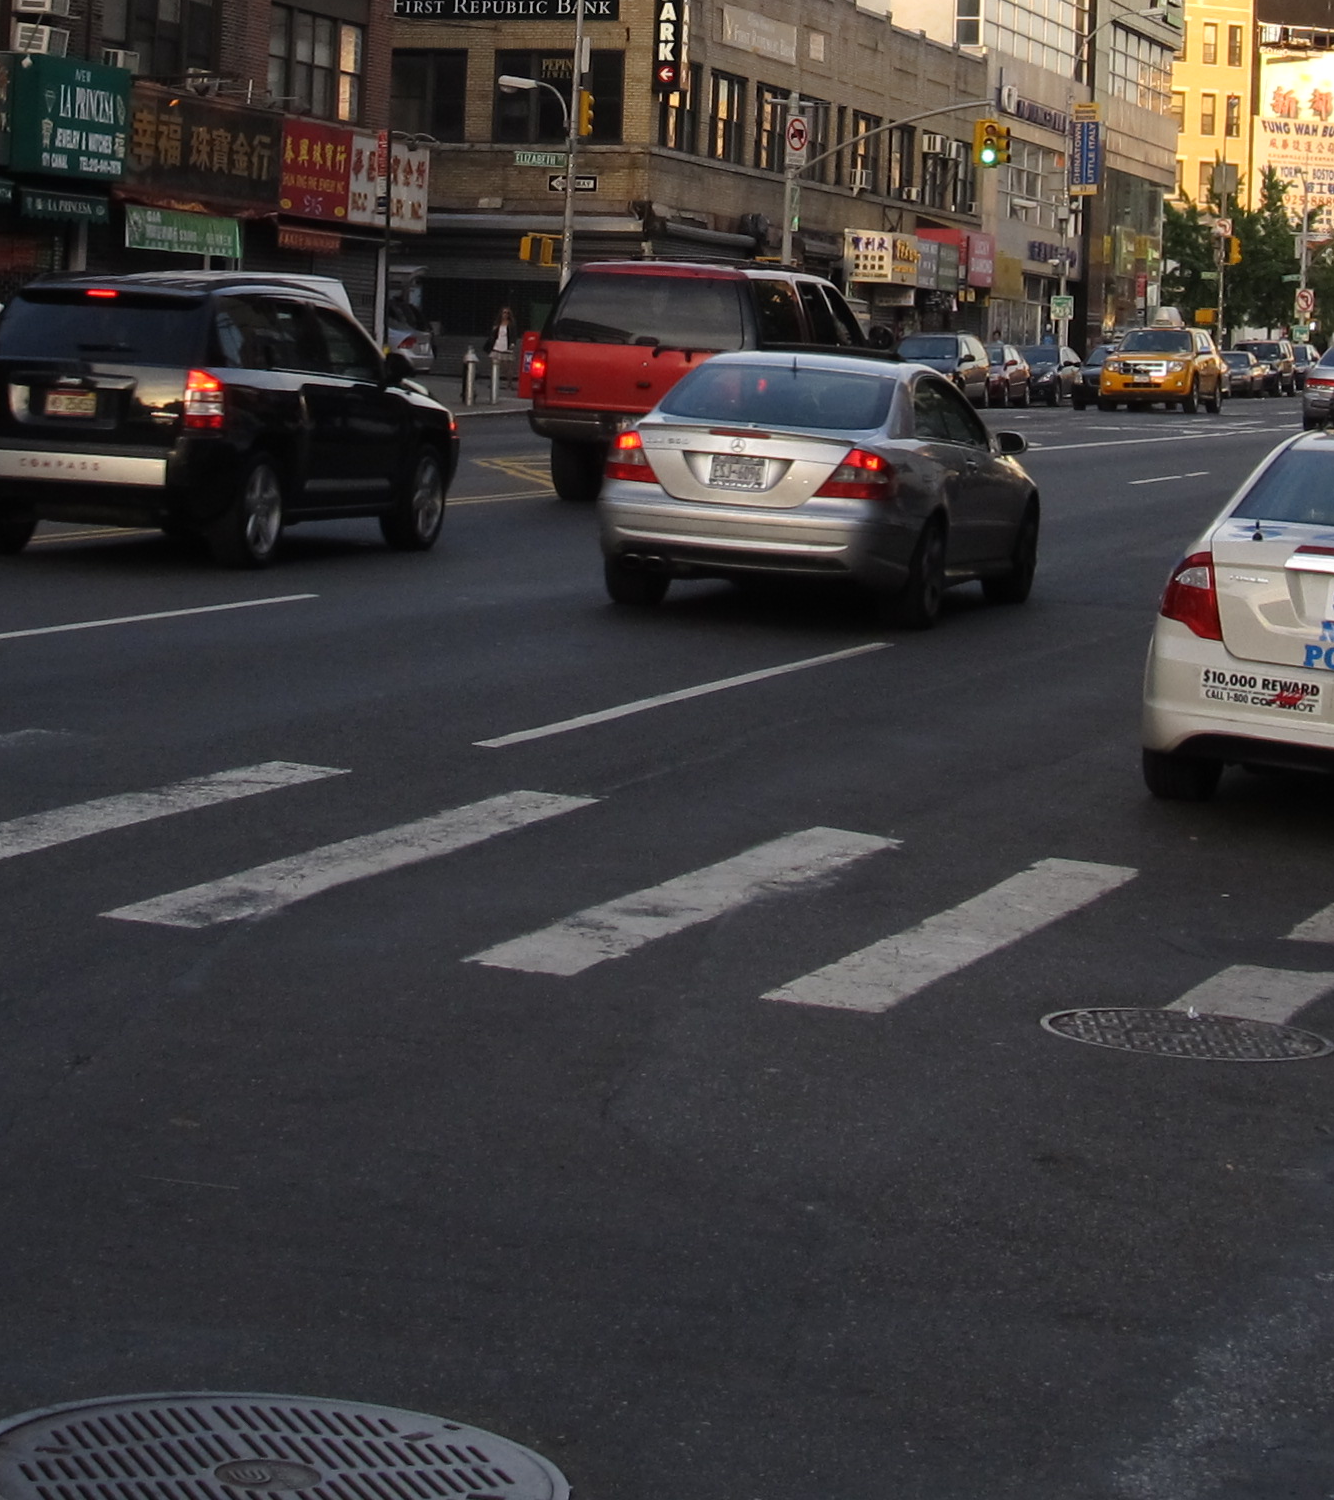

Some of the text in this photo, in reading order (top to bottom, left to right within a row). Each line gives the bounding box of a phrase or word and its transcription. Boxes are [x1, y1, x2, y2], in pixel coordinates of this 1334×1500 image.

[60, 84, 115, 125] LA PRINCESA
[1261, 119, 1291, 135] FUNG
[1294, 123, 1318, 137] WAH
[130, 109, 273, 180] 幸福 珠寶金行
[1073, 122, 1082, 185] CHINATOWN
[515, 153, 557, 165] ELIZABETH
[19, 457, 102, 473] COMPASS
[1203, 668, 1320, 697] $10,000 REWARD
[1205, 689, 1224, 701] CALL
[1227, 692, 1249, 704] 1-800
